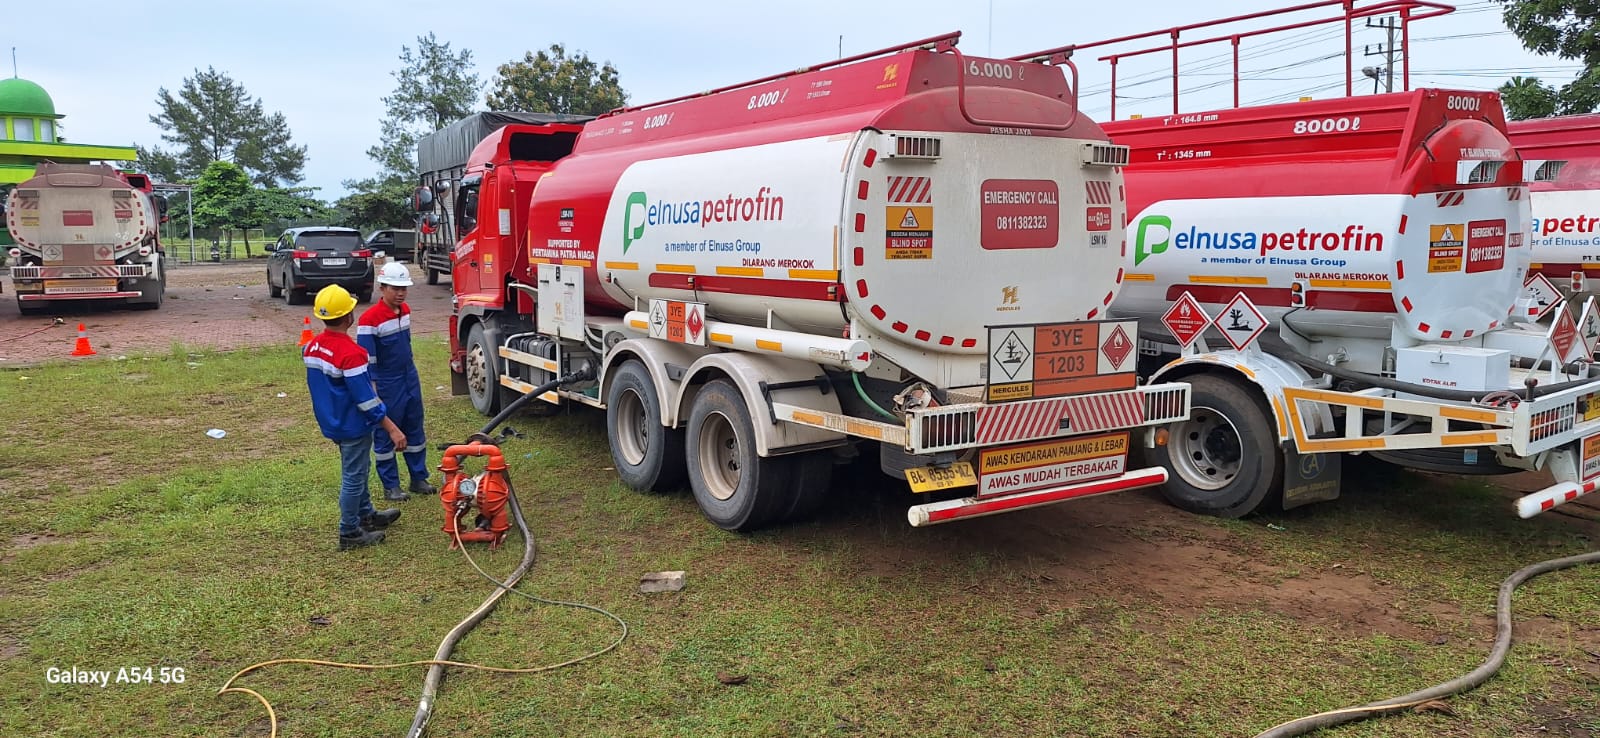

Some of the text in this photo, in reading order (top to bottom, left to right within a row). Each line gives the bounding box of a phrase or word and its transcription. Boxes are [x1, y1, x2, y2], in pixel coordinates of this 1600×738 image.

[748, 90, 779, 110] 8.000
[644, 114, 668, 130] 8.000
[1180, 114, 1202, 124] 164.8
[1203, 114, 1218, 122] mm
[990, 127, 1032, 136] PASHA JAYA
[1174, 150, 1194, 159] 1345
[1196, 150, 1211, 158] mm
[984, 192, 1056, 204] EMERGENCY CALL
[996, 216, 1047, 230] 0811382323
[1542, 214, 1600, 236] petr
[1472, 226, 1504, 238] EMERGENCY CALL
[548, 239, 580, 248] SUPPORTED BY
[891, 239, 928, 248] BLIND SPOT
[1092, 234, 1106, 245] LSM 16
[1542, 237, 1553, 246] of
[1555, 237, 1589, 246] Elnusa
[670, 241, 697, 252] member
[700, 240, 707, 251] of
[709, 240, 734, 252] Elnusa
[735, 240, 760, 254] Group
[532, 248, 595, 260] PERTAMINA PATRA NIAGA
[1470, 246, 1502, 262] 0811382323
[742, 258, 815, 269] DILARANG MEROKOK
[1210, 256, 1252, 264] member
[1270, 257, 1307, 266] Elnusa
[1311, 258, 1346, 267] Group
[1294, 272, 1388, 281] DILARANG MEROKOK
[670, 306, 682, 317] 3YE
[1052, 328, 1083, 346] 3YE
[1049, 355, 1085, 374] 1203
[992, 385, 1030, 394] HERCULES
[986, 438, 1124, 468] AWAS KENDARAAN PANJANG & LEBAR
[988, 460, 1118, 490] AWAS MUDAH TERBAKAR
